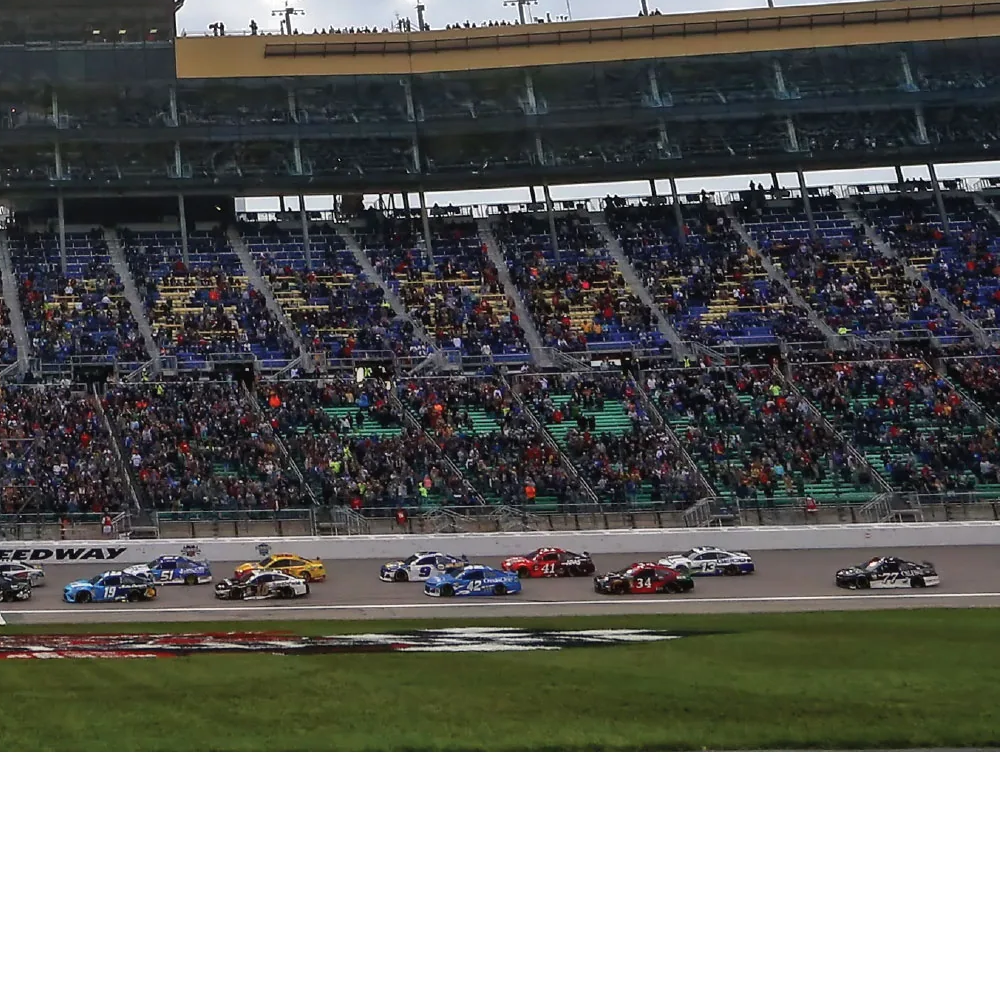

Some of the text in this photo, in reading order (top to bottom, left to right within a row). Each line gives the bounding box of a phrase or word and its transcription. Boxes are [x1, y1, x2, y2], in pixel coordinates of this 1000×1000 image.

[419, 566, 432, 577] 9
[541, 563, 555, 574] 41
[702, 562, 716, 572] 13
[160, 570, 174, 581] 51
[881, 572, 899, 585] 77
[466, 580, 482, 592] 42
[636, 577, 652, 589] 34
[104, 586, 117, 598] 19
